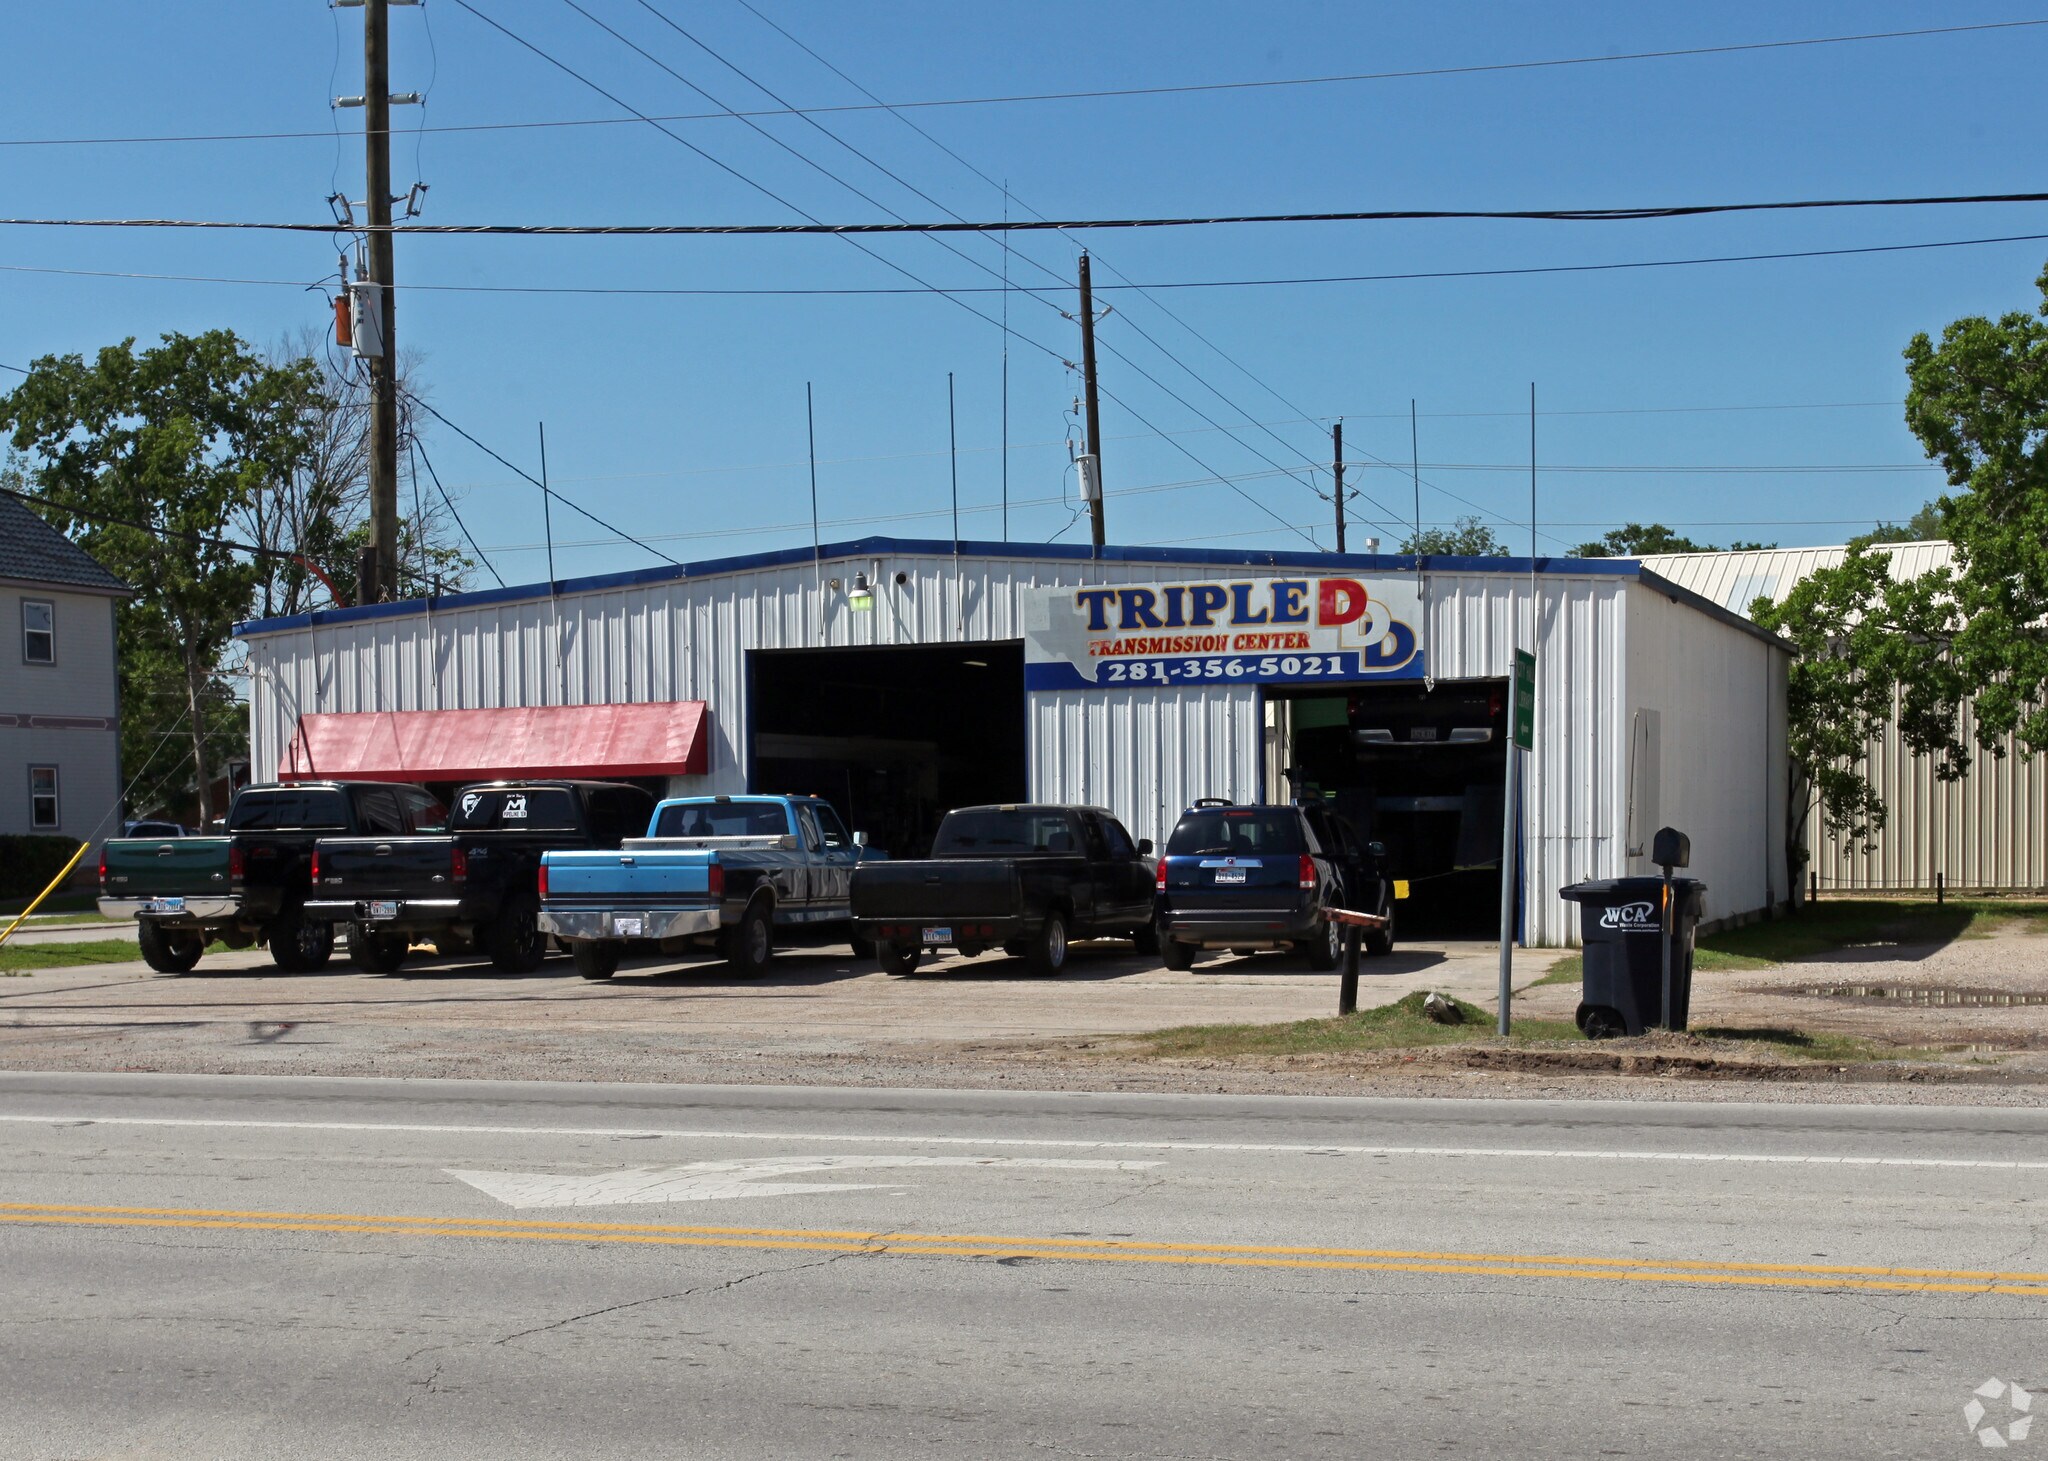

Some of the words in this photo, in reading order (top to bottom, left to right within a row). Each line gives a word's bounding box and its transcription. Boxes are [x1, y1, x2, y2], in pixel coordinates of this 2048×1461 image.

[1076, 580, 1311, 631] TRIPLE
[1317, 577, 1368, 626] D
[1088, 633, 1229, 656] TRANSMISSION
[1233, 631, 1311, 651] CENTER
[1108, 656, 1345, 682] 281-356-5021
[1605, 907, 1647, 922] WCA
